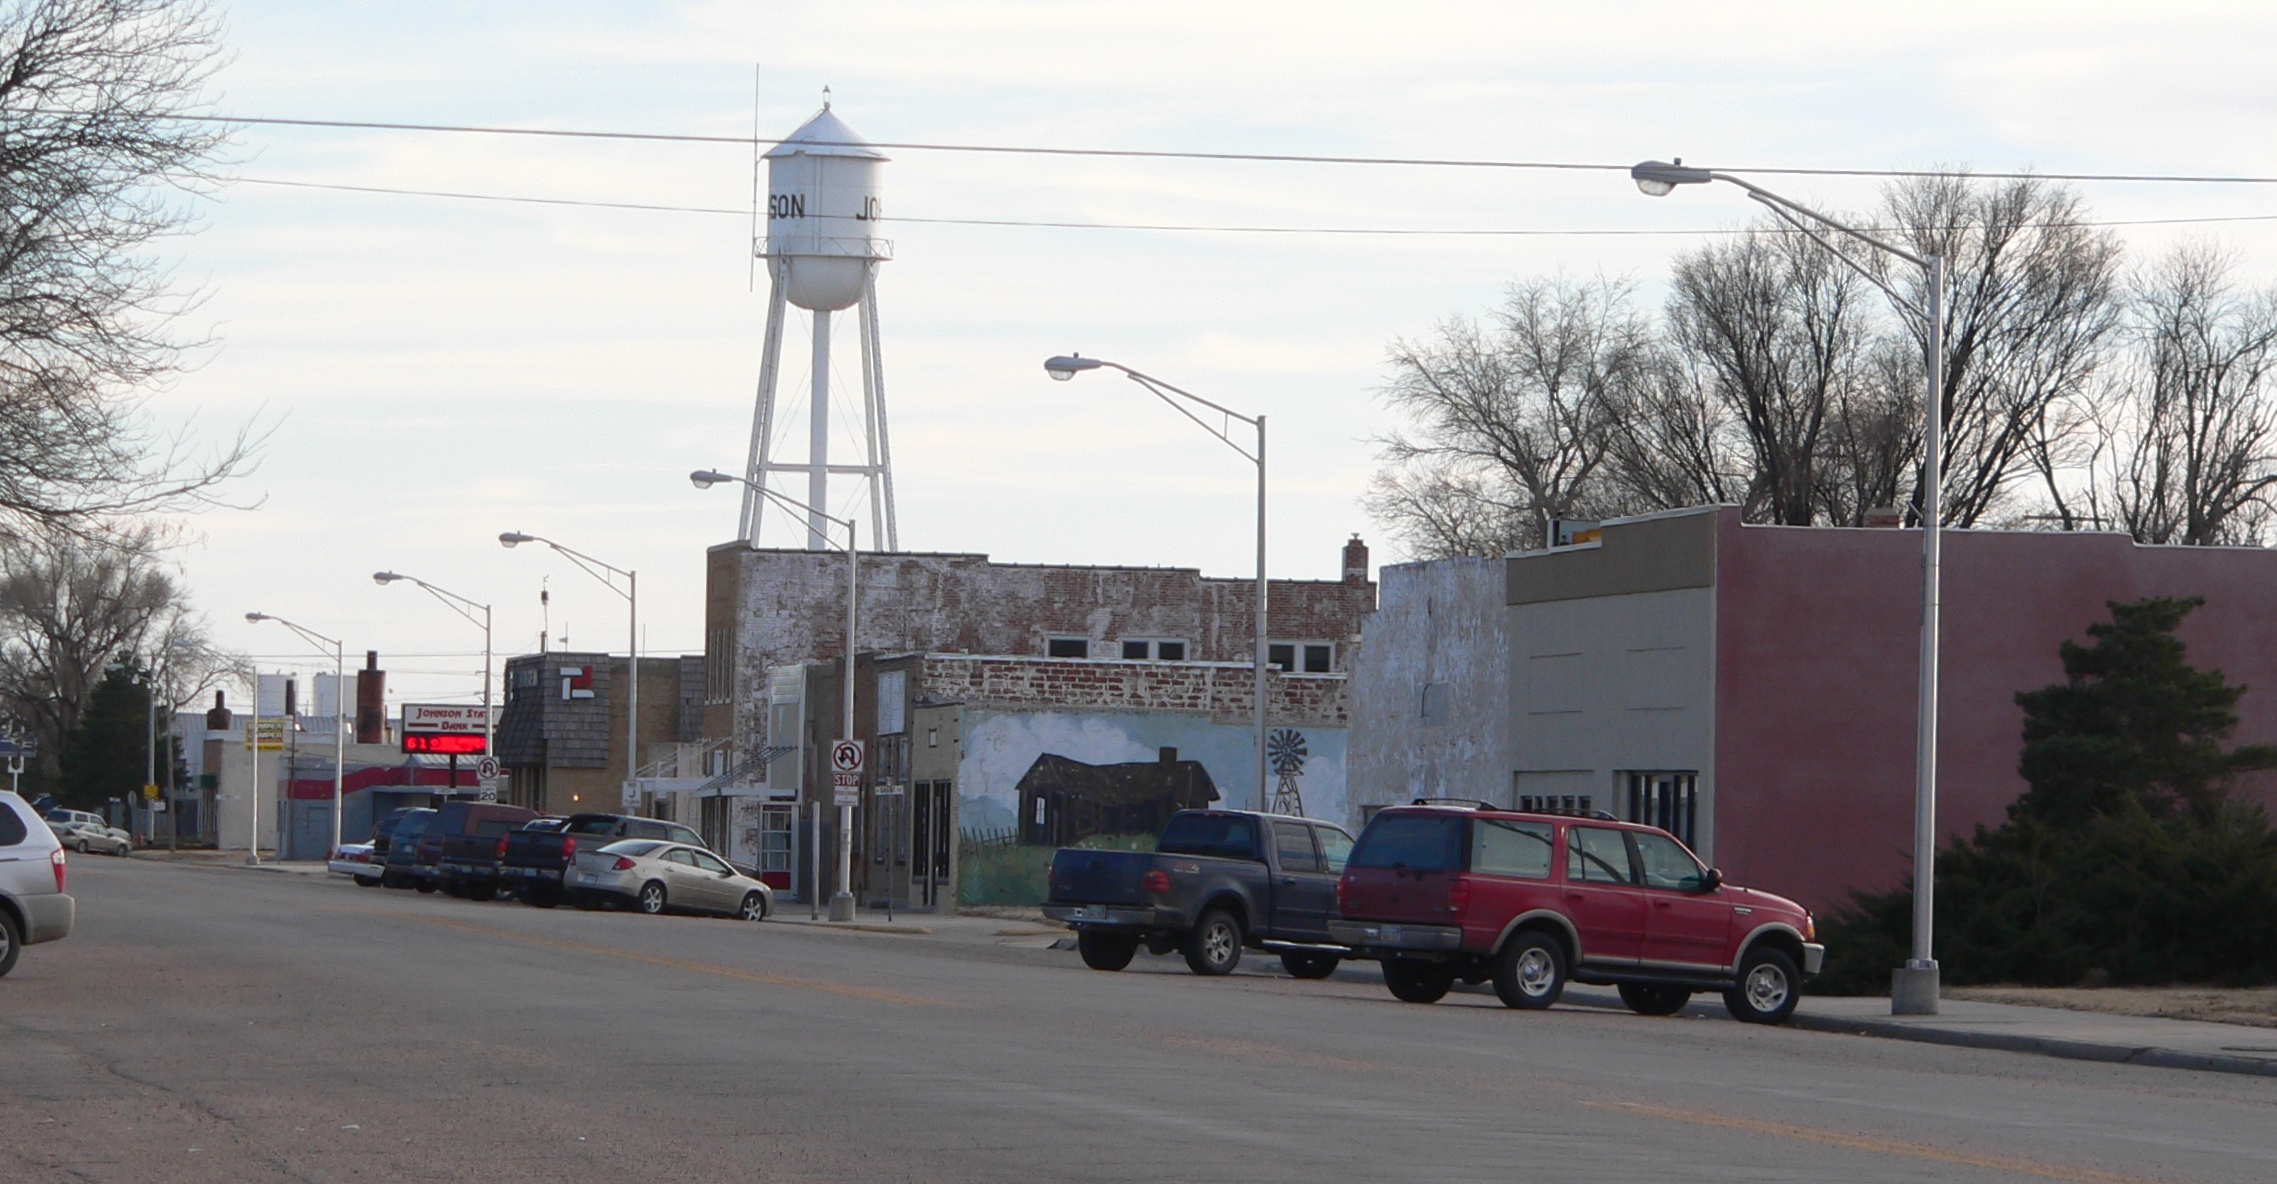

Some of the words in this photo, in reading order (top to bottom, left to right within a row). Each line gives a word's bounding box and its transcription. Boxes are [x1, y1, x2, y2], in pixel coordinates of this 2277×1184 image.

[416, 707, 462, 719] JOHNSON
[441, 721, 468, 731] BANK
[835, 774, 859, 786] STOP
[481, 792, 496, 801] 20
